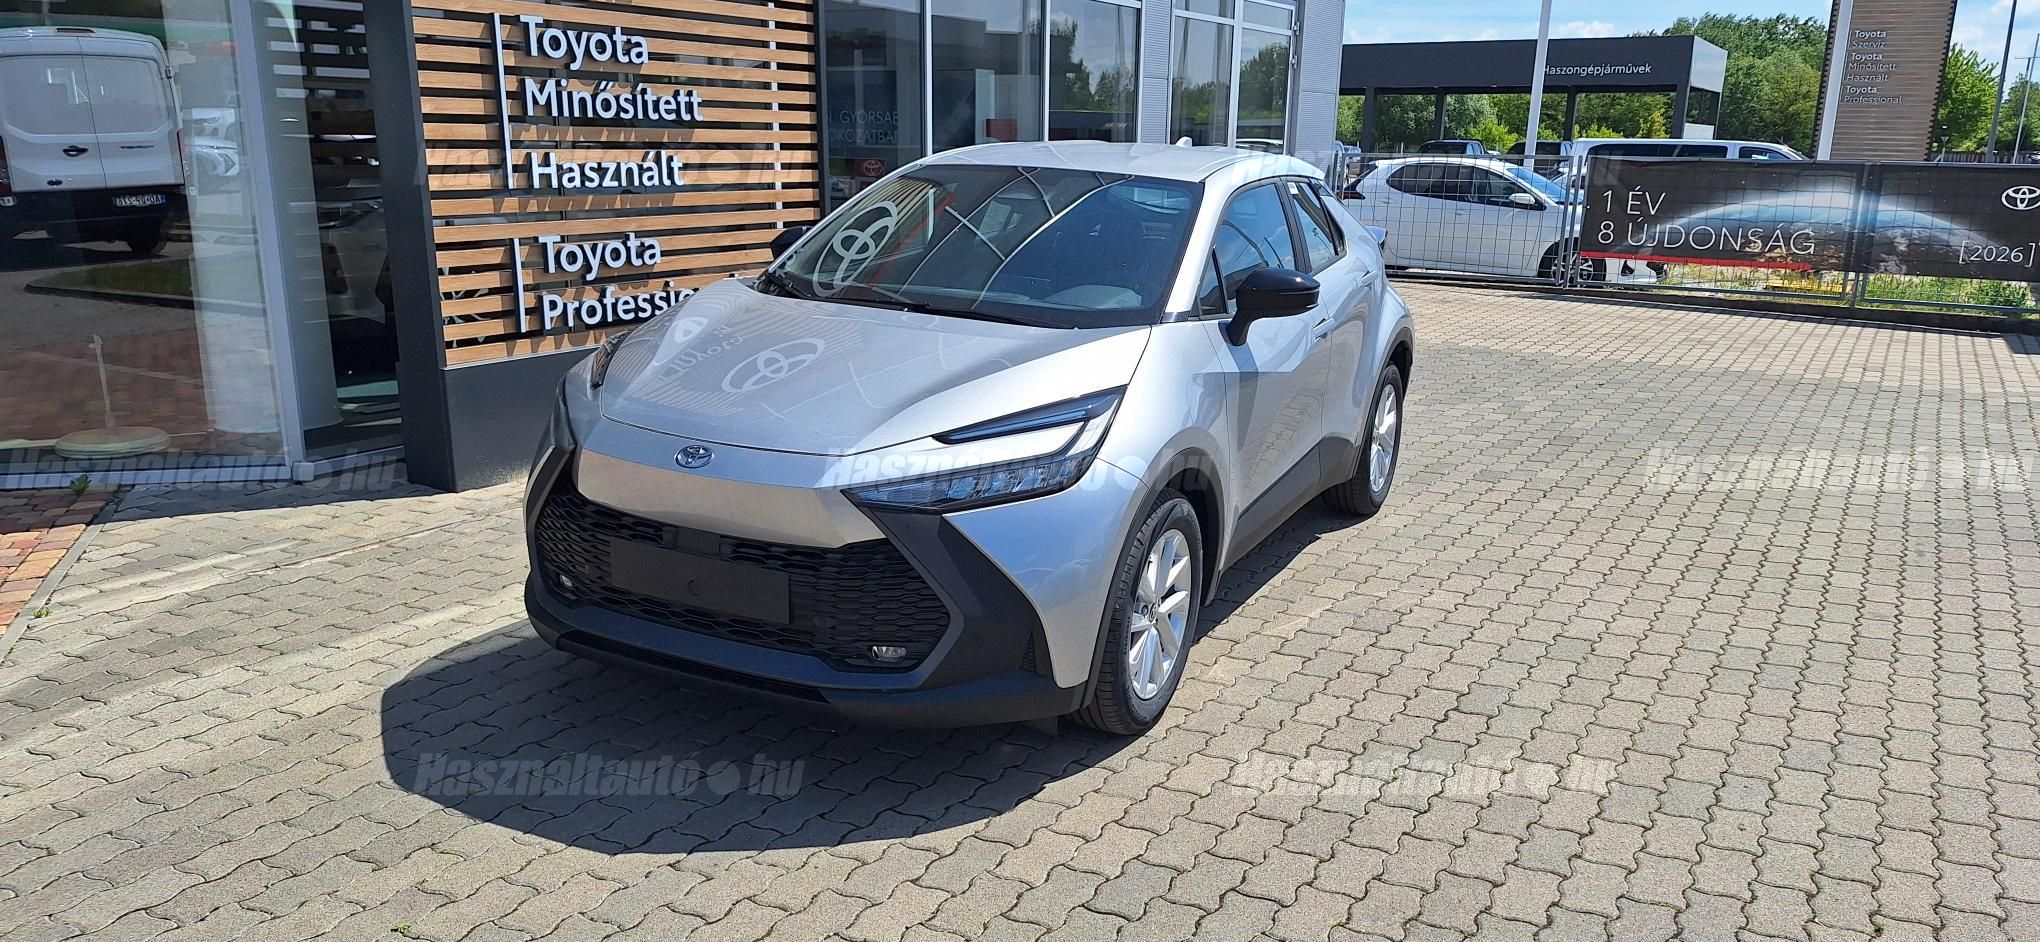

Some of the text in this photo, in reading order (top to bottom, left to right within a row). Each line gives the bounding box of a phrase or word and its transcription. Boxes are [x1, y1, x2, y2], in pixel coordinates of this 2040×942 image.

[519, 14, 649, 71] Toyota
[1851, 40, 1887, 49] Szerviz
[1854, 30, 1887, 40] Toyota
[1850, 52, 1883, 61] Toyota
[1543, 62, 1652, 77] Haszongépjárművek
[1846, 73, 1889, 82] Használt
[523, 78, 704, 122] Minősített
[1843, 95, 1903, 104] Professional
[1845, 85, 1878, 95] Toyota
[530, 150, 685, 189] Használt
[1602, 185, 1666, 216] 1 ÉV
[1598, 217, 1816, 256] 8 ÚJDONSÁG
[538, 232, 662, 281] Toyota
[1958, 240, 2036, 268] [2026]
